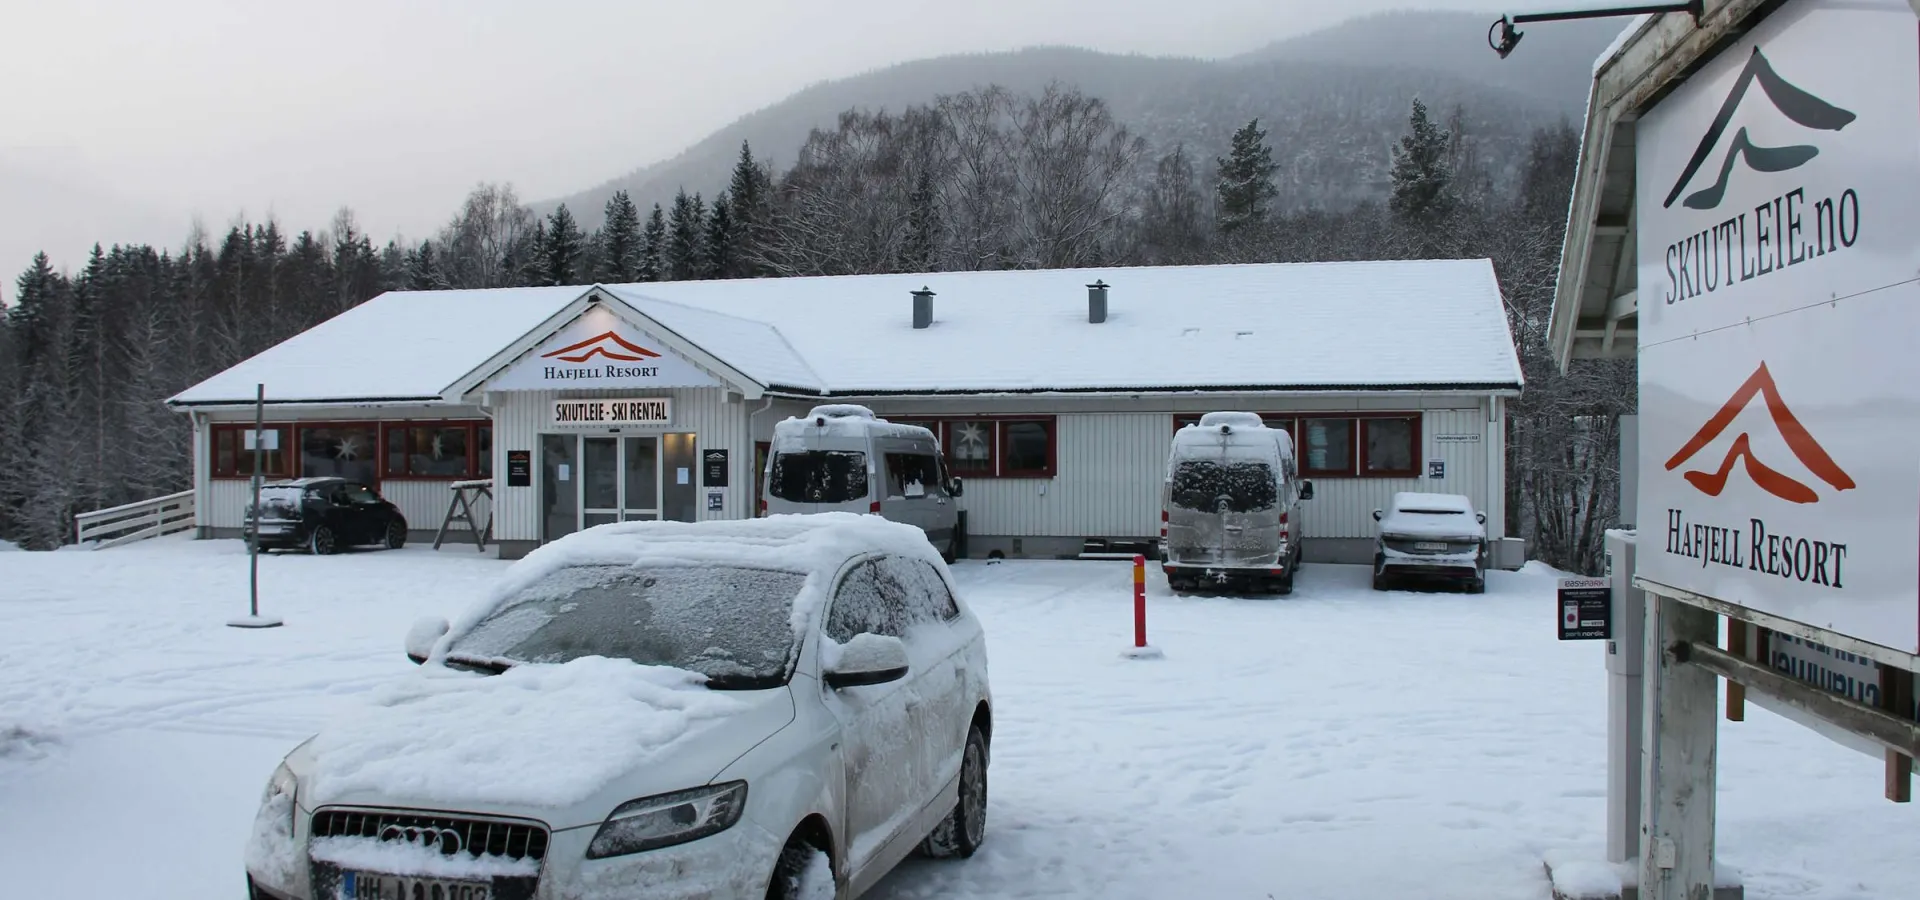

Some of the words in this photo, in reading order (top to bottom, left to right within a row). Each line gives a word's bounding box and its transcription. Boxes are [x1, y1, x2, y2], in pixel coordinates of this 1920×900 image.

[1666, 187, 1860, 305] SKIUTLEIE.no
[544, 366, 602, 380] HAFJELL
[606, 365, 659, 378] RESORT
[555, 403, 604, 421] SKIUTLEIE
[612, 402, 628, 420] SKI
[630, 402, 668, 420] RENTAL
[1666, 508, 1744, 569] HAFJELL
[1749, 518, 1847, 589] RESORT
